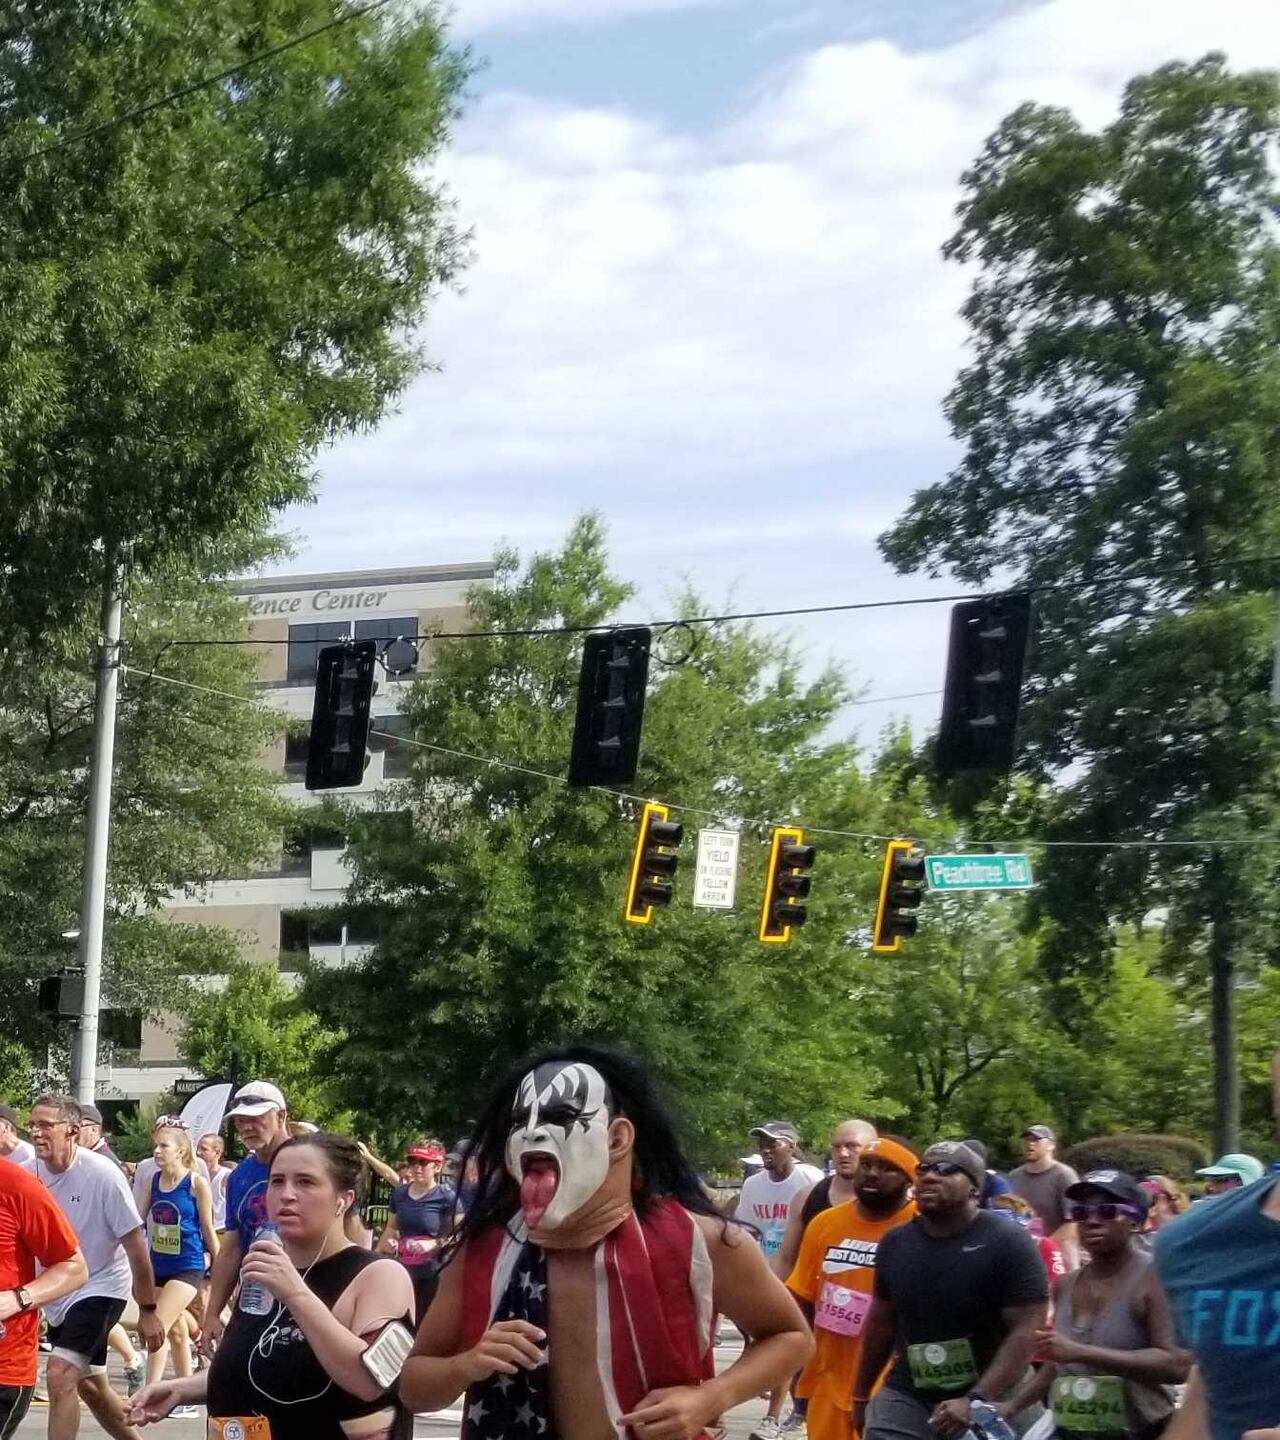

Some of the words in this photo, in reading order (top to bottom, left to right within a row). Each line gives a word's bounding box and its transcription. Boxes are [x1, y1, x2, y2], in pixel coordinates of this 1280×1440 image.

[312, 590, 388, 612] Center
[707, 849, 730, 863] YIELD
[753, 1203, 788, 1220] ATLAN
[824, 1303, 863, 1325] 15545
